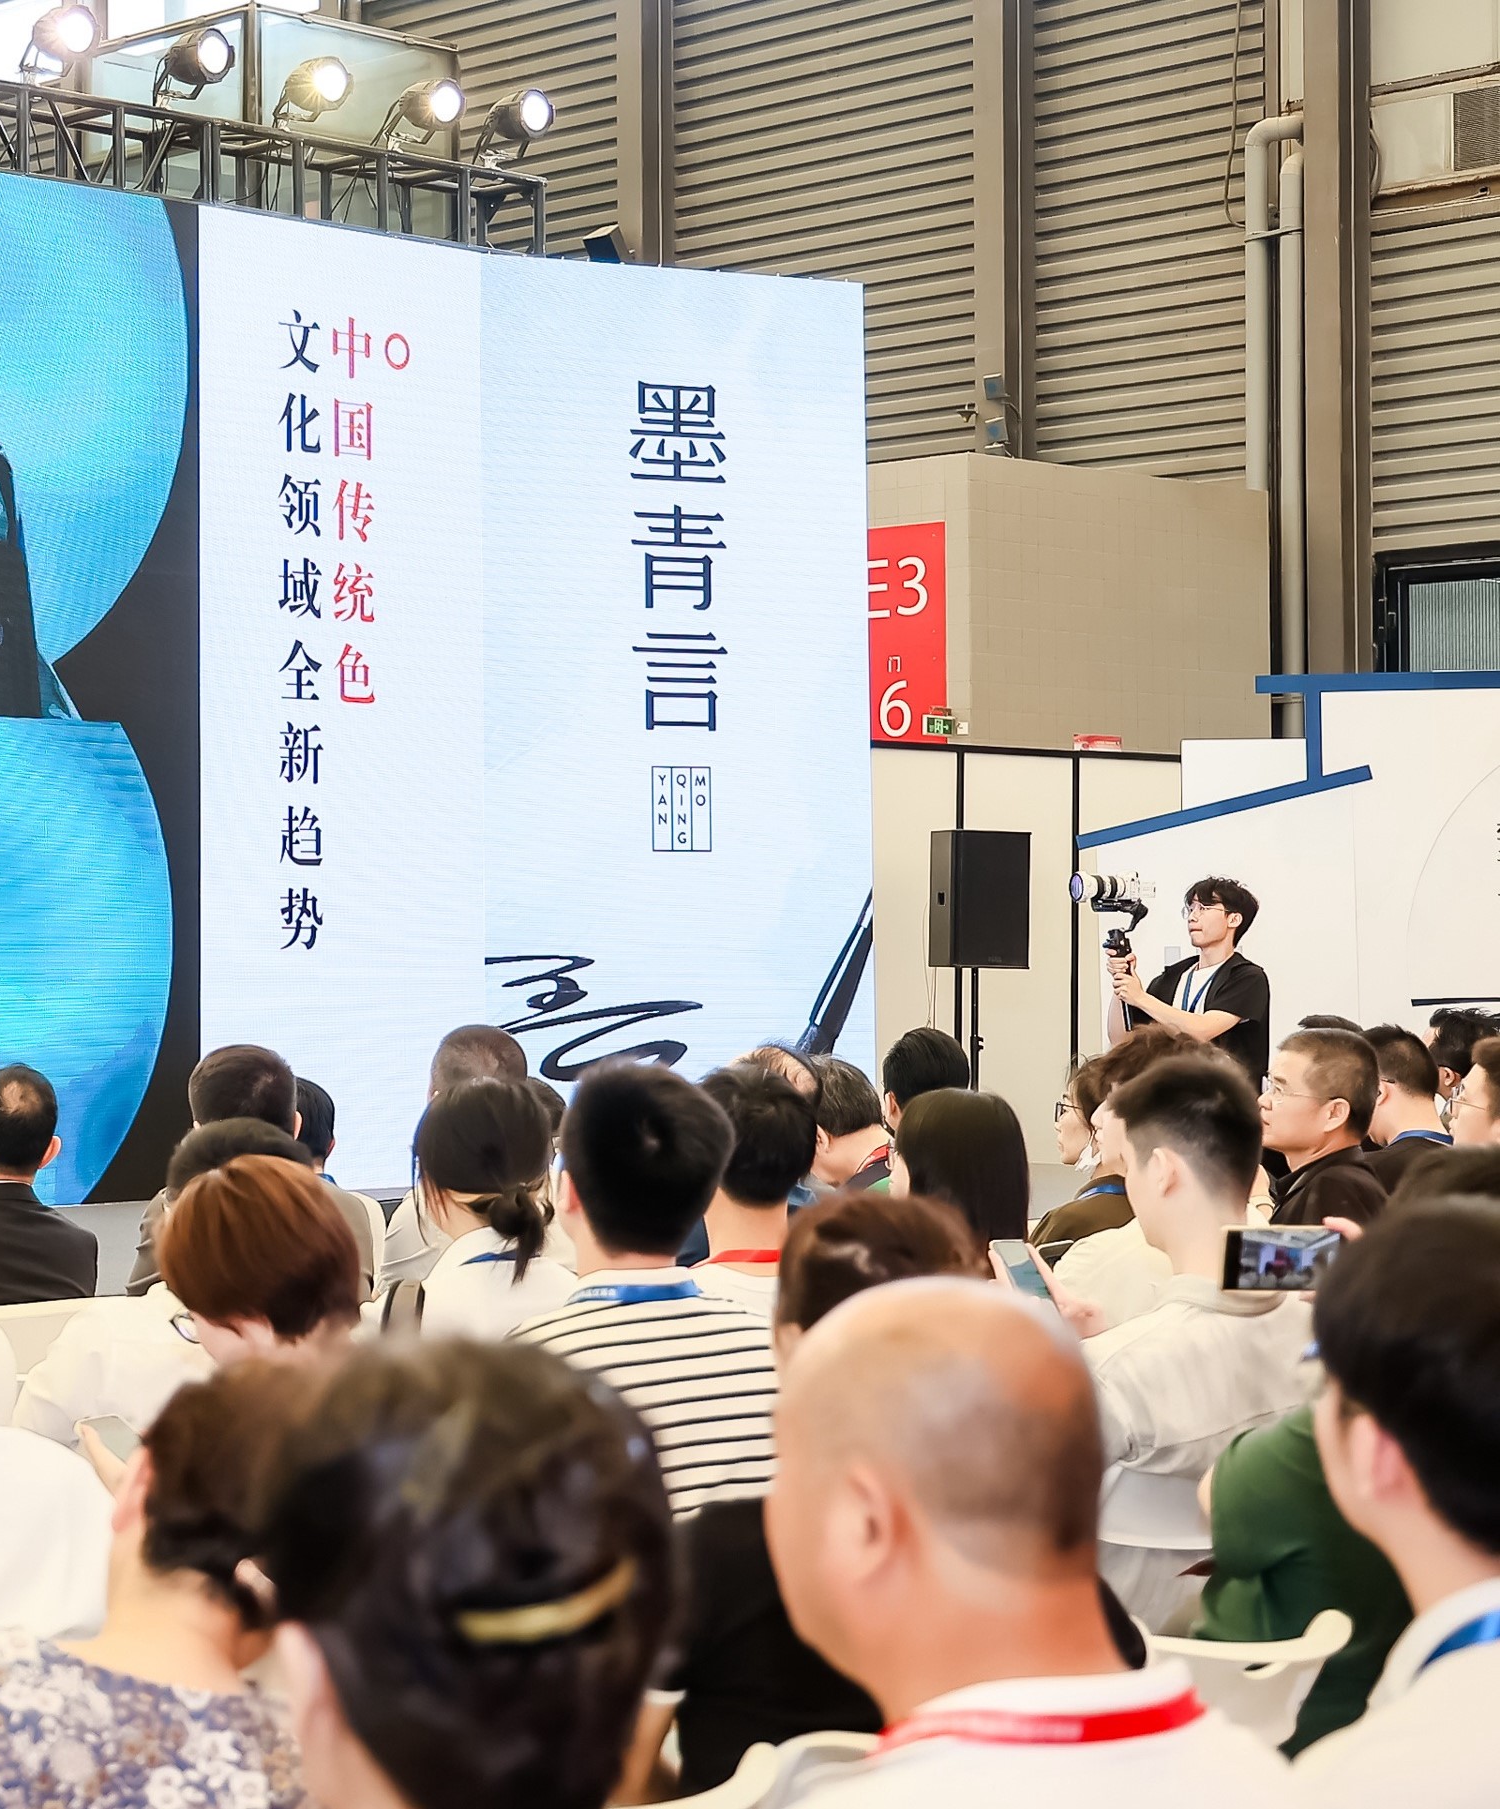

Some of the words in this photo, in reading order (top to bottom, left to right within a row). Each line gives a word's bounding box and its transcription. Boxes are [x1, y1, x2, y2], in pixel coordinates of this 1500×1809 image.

[332, 316, 376, 706] 中国传统色
[628, 380, 728, 733] 墨青言
[277, 309, 325, 951] 文化领域全新趋势
[879, 679, 913, 738] 6
[657, 774, 668, 826] YAN
[676, 773, 688, 845] QING
[694, 775, 706, 806] MO
